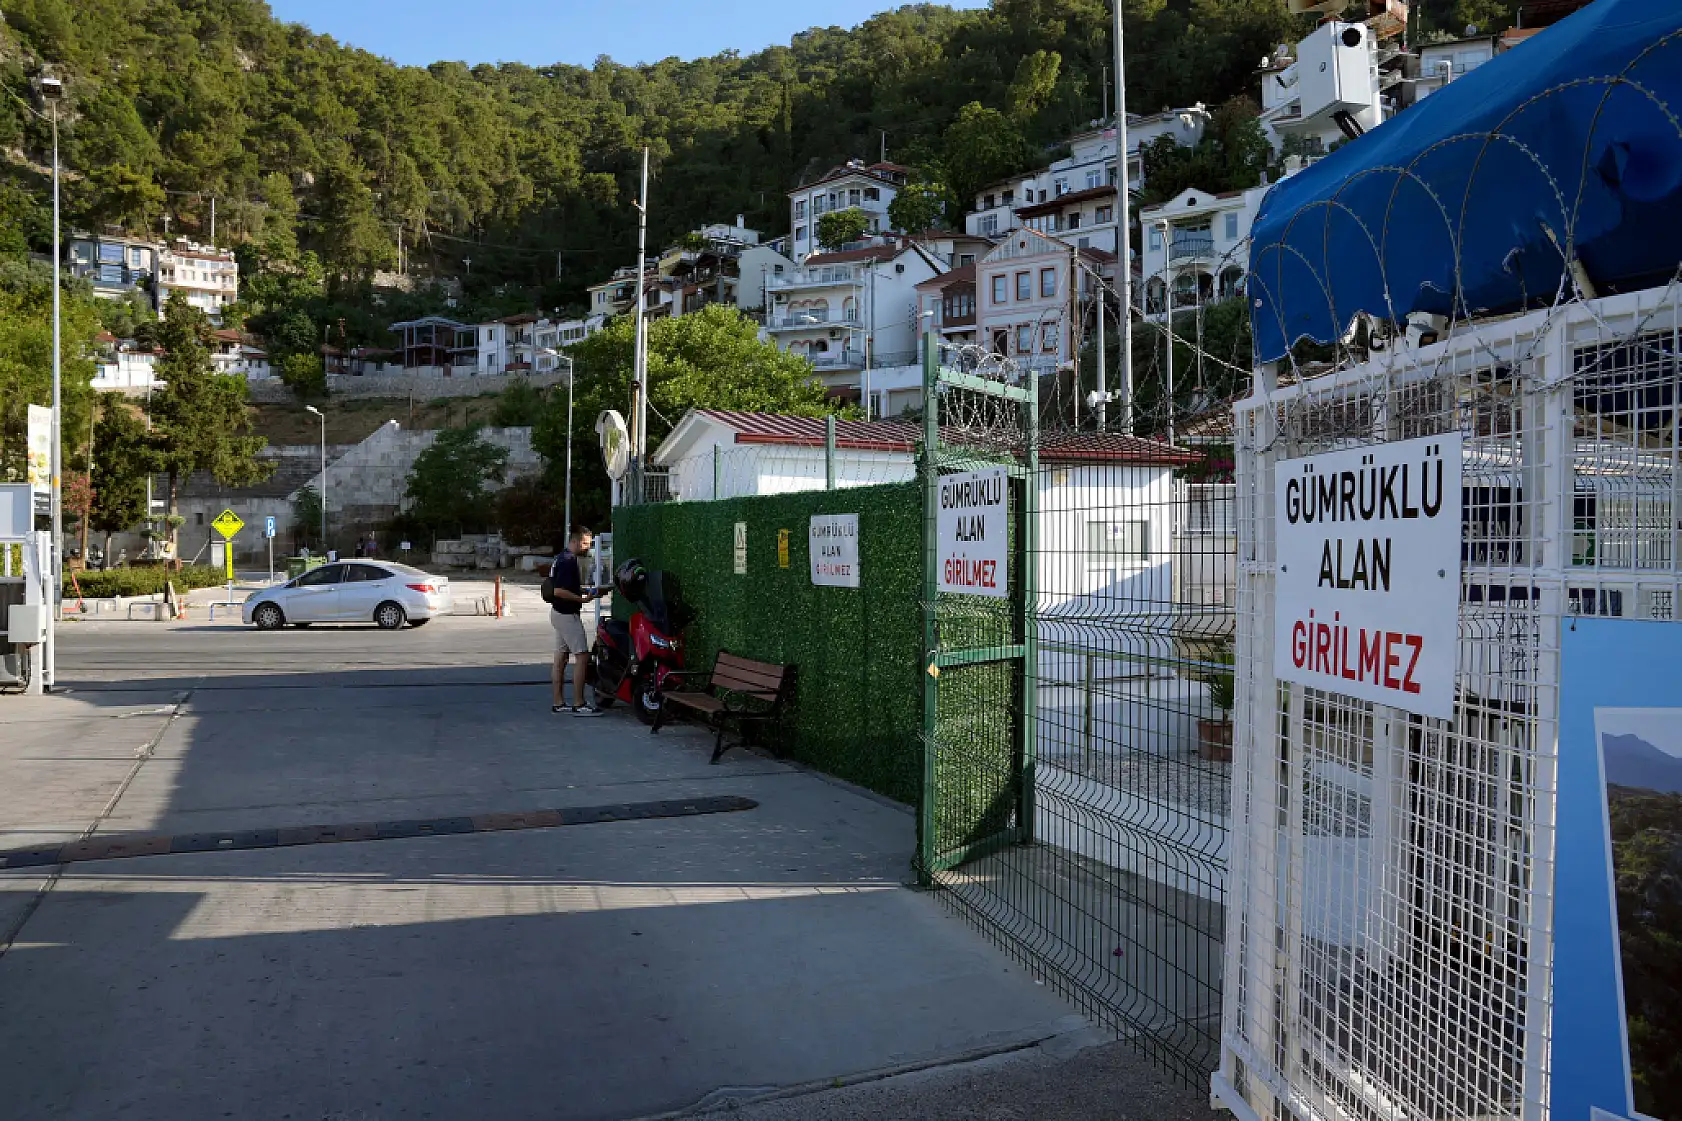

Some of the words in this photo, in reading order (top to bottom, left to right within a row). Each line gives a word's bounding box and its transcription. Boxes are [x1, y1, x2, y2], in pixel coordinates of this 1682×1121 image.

[942, 470, 1001, 509] GÜMRÜKLÜ
[1286, 444, 1443, 524] GÜMRÜKLÜ
[956, 514, 985, 542] ALAN
[821, 545, 841, 557] ALAN
[945, 552, 997, 588] GİRİLMEZ
[1317, 538, 1392, 592] ALAN
[1292, 609, 1423, 694] GİRİLMEZ
